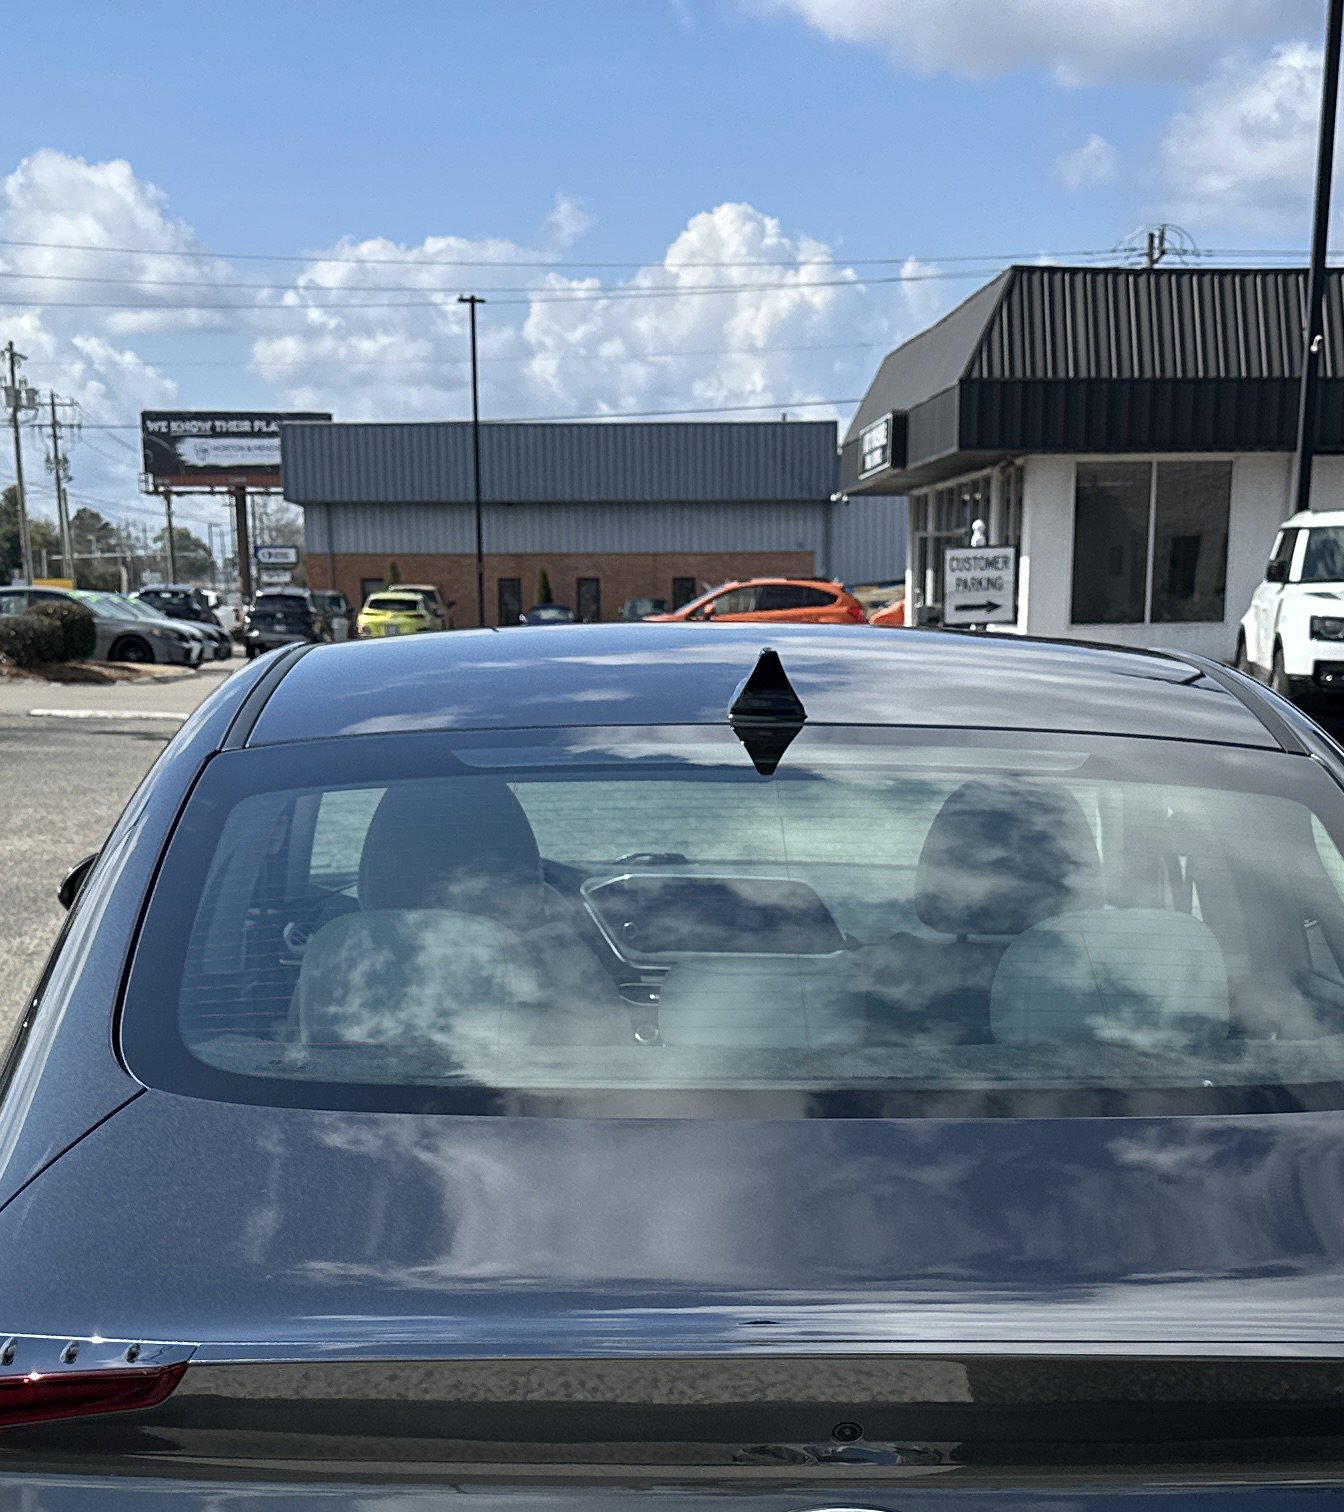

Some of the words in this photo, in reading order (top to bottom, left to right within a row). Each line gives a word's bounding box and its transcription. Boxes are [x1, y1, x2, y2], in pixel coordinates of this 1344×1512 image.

[145, 420, 168, 433] WE
[170, 420, 212, 434] KNOW
[214, 420, 252, 433] THEIR
[949, 555, 1010, 573] CUSTOMER
[955, 576, 1004, 593] PARKING
